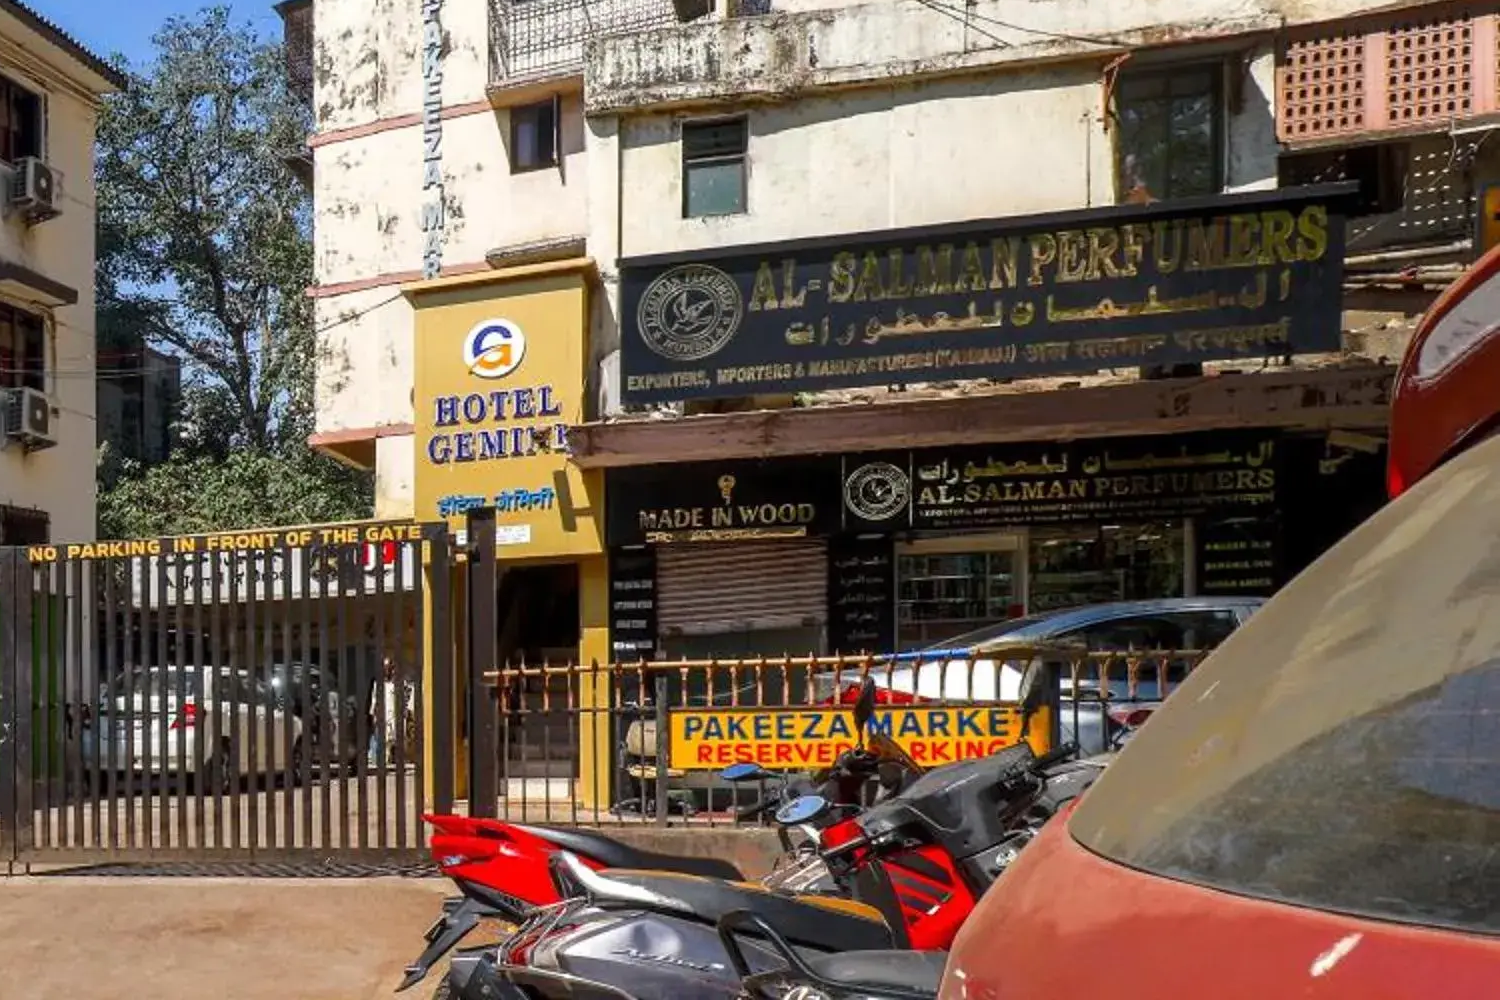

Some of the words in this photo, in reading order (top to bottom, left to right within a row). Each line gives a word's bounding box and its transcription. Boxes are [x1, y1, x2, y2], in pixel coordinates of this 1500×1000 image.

[1027, 205, 1328, 287] PERFUMERS
[434, 385, 562, 427] HOTEL
[918, 478, 1089, 505] AL-SALMAN
[1094, 466, 1276, 498] PERFUMERS
[639, 508, 704, 530] MADE
[711, 506, 733, 527] IN
[739, 502, 816, 524] WOOD
[29, 546, 57, 562] NO
[67, 539, 161, 560] PARKING
[173, 538, 195, 554] IN
[207, 533, 279, 551] FRONT
[286, 530, 312, 547] OF
[322, 527, 360, 545] THE
[366, 524, 422, 542] GATE
[684, 713, 852, 741] PAKEEZA
[867, 709, 1027, 738] MARKE
